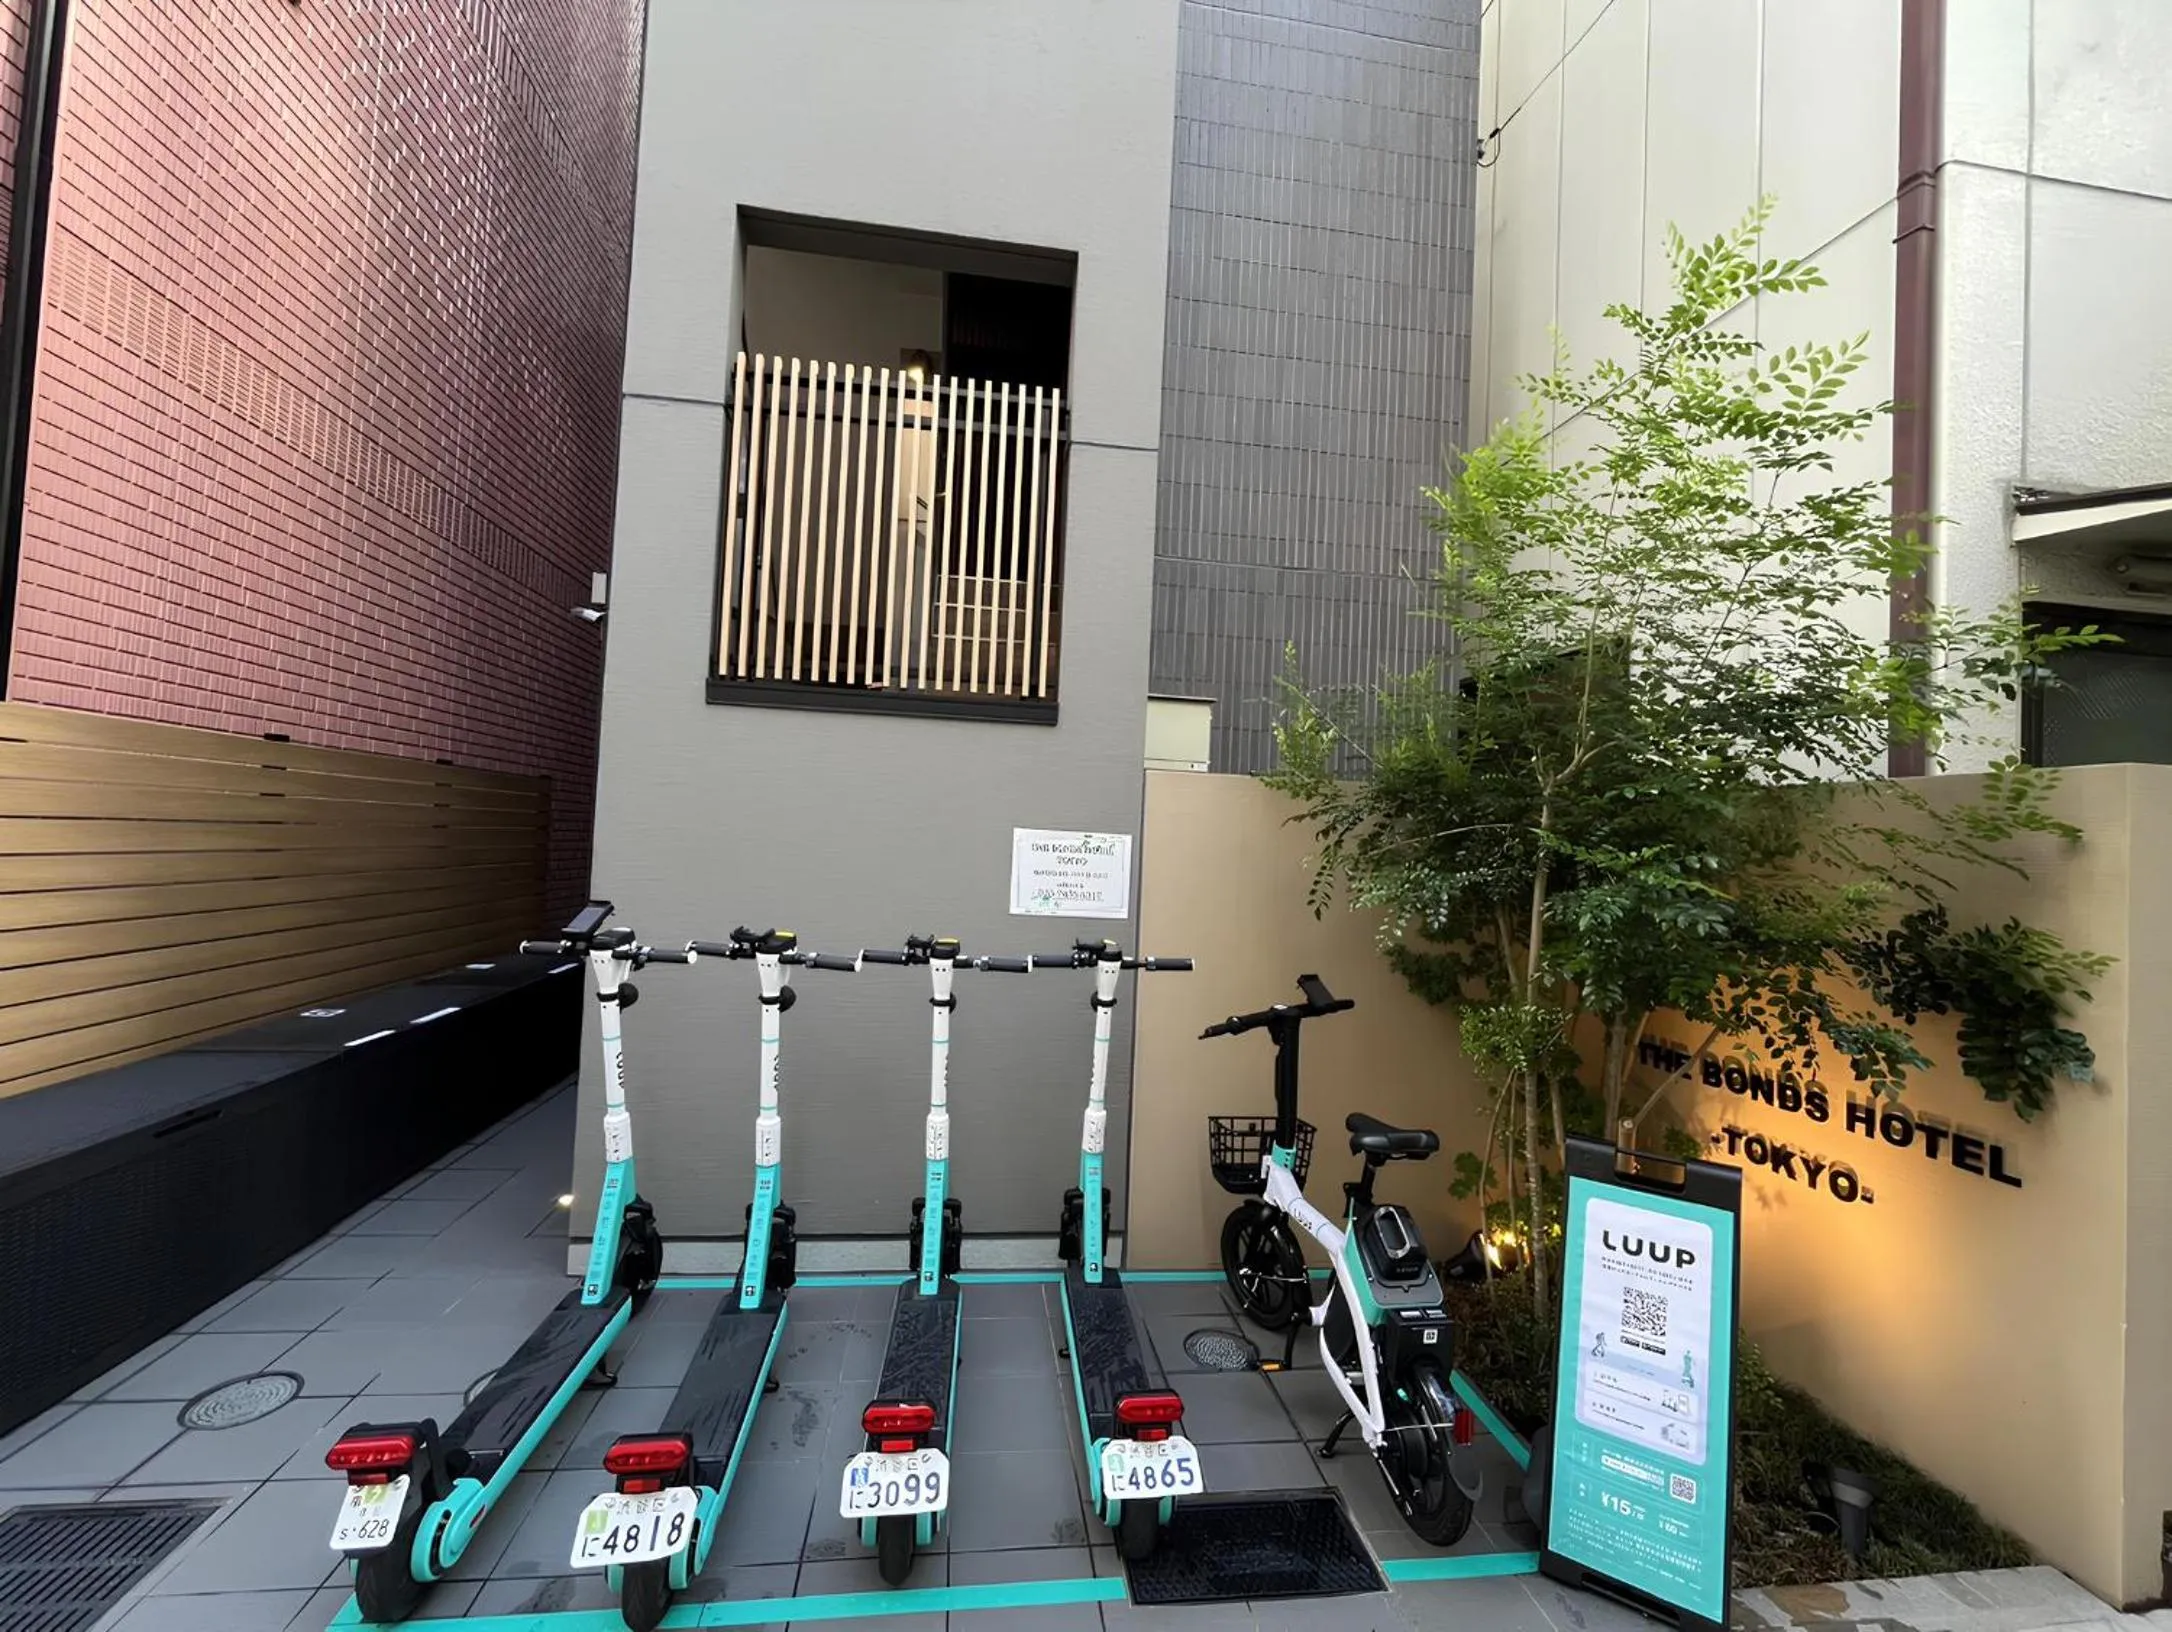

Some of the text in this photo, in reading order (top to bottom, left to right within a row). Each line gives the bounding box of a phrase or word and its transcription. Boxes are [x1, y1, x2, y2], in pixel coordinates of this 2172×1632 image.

[1638, 1040, 2022, 1188] THE BONDS HOTEL
[1602, 1230, 1696, 1268] LUUP
